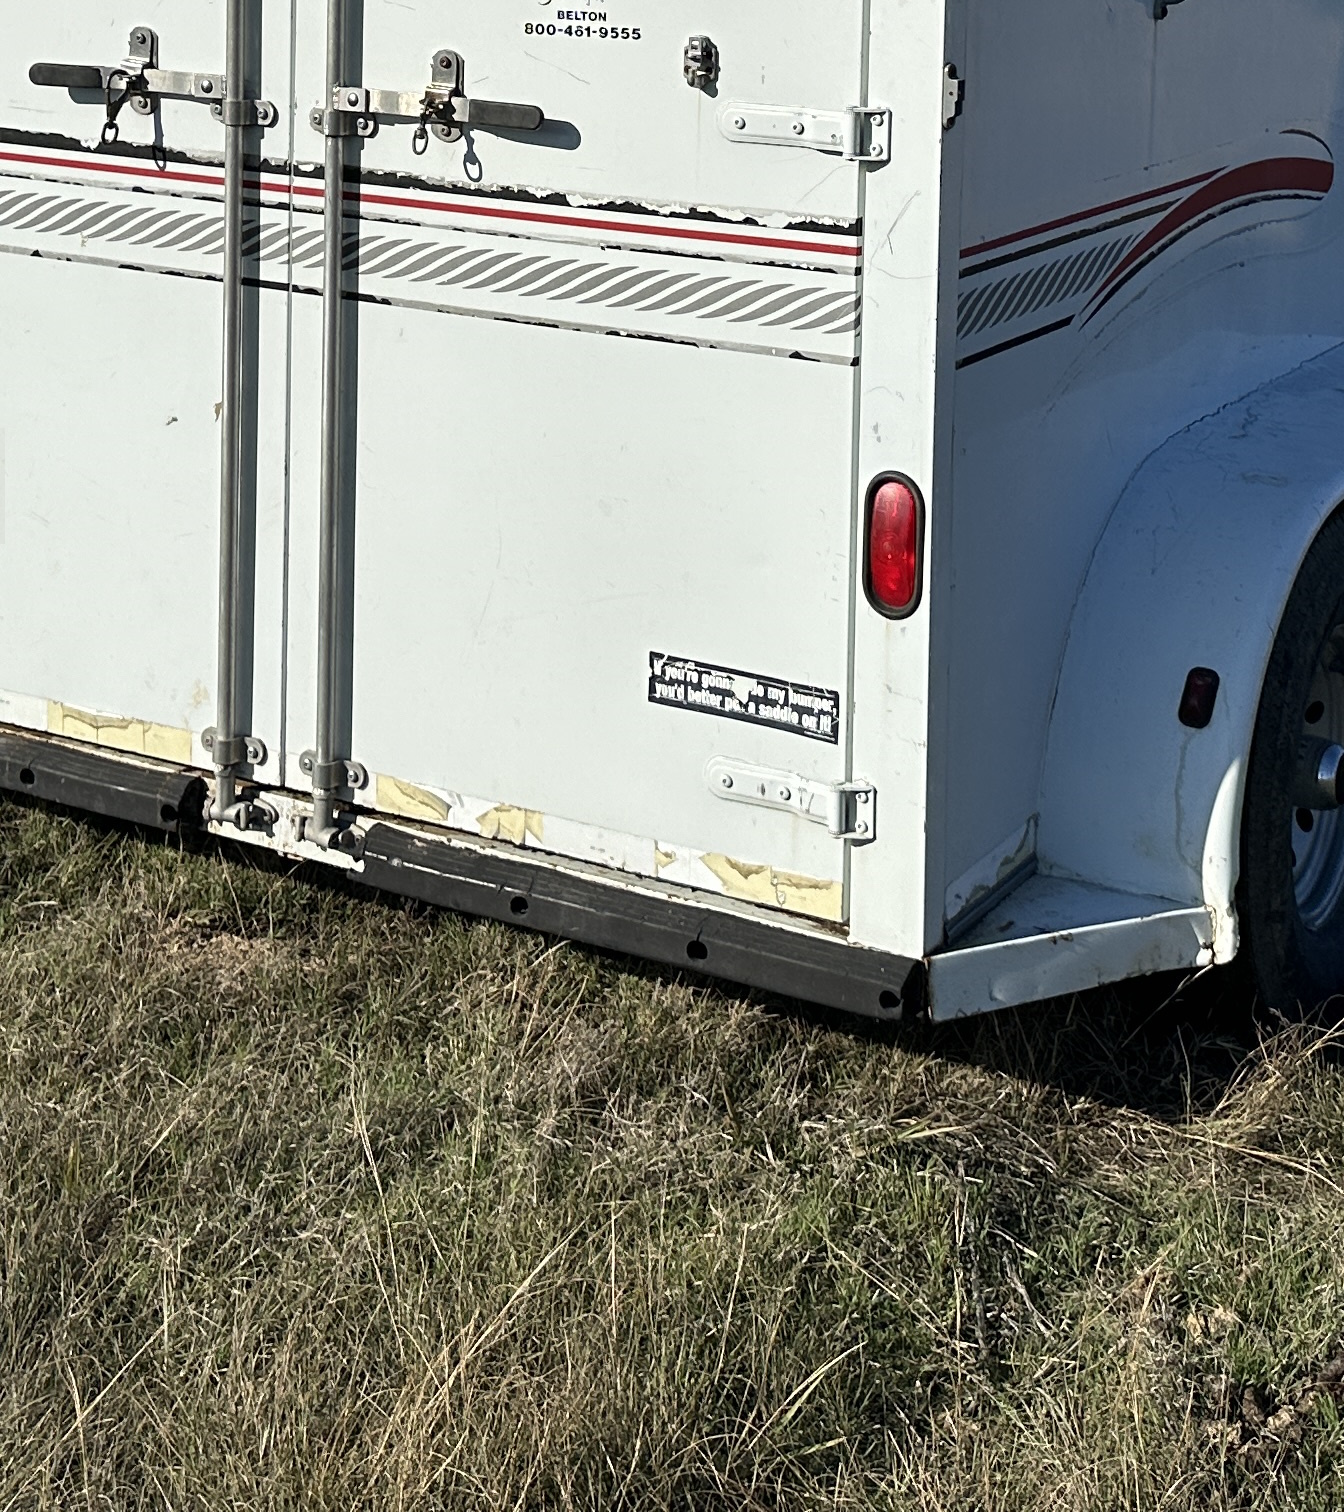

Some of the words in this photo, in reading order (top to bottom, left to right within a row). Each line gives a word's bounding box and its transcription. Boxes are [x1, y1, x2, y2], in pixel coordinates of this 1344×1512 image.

[557, 10, 607, 21] BELTON
[524, 22, 641, 40] 800-461-9555
[655, 682, 685, 699] you'd
[767, 686, 785, 705] my
